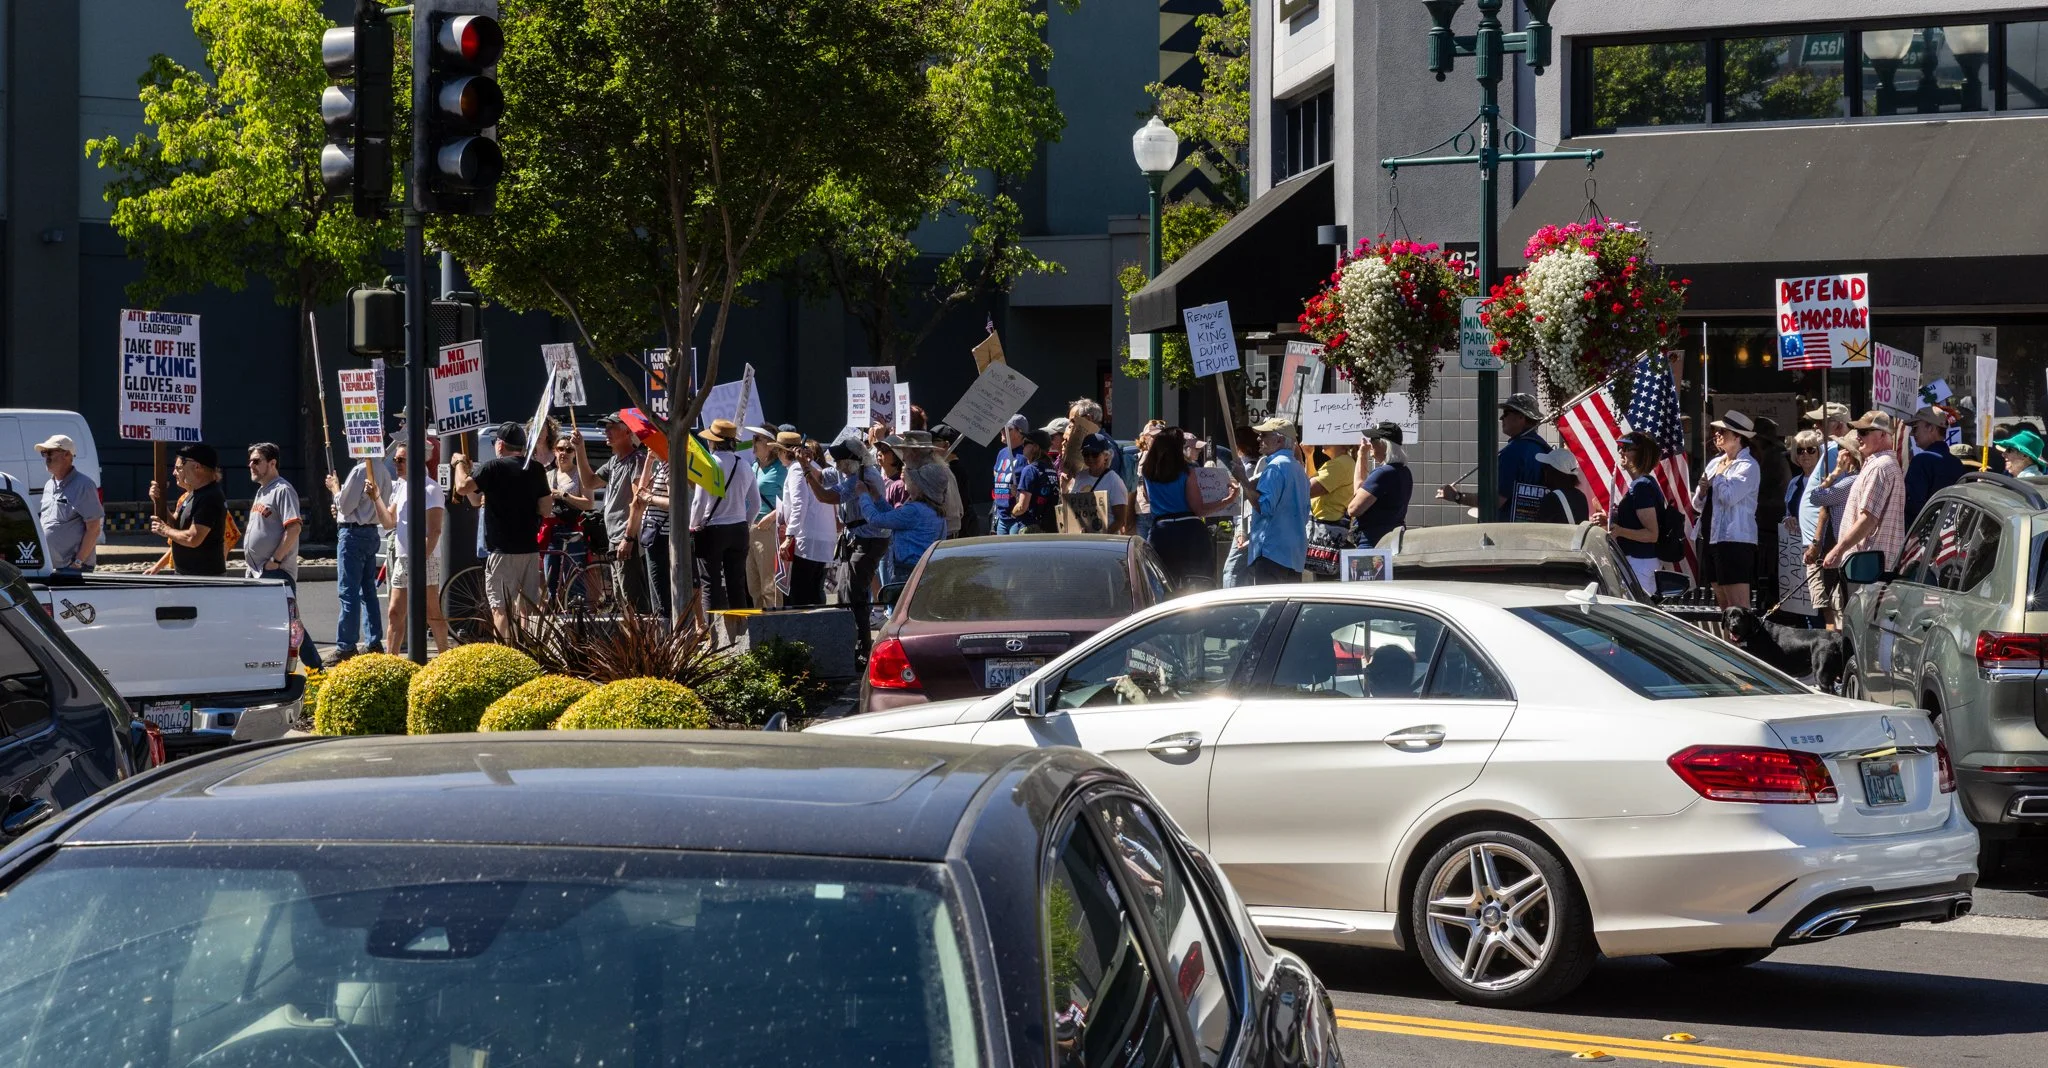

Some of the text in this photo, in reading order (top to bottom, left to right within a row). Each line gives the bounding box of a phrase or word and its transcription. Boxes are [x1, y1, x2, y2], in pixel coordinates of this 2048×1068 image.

[1781, 278, 1865, 305] DEFEND
[128, 311, 192, 326] ATTN: DEMOCRATIC
[1186, 310, 1224, 323] REMOVE
[1781, 306, 1868, 332] DEMOCRACY
[139, 323, 182, 336] LEADERSHIP
[1199, 321, 1216, 329] THE
[1197, 328, 1227, 342] KING
[125, 338, 196, 357] TAKE OFF THE
[1200, 343, 1229, 357] DUMP
[447, 349, 464, 362] NO
[1474, 358, 1492, 366] ZONE
[1876, 347, 1891, 367] NO
[434, 358, 479, 379] IMMUNITY
[1196, 356, 1236, 372] TRUMP
[868, 370, 890, 384] KINGS
[1875, 369, 1891, 387] NO
[1891, 374, 1917, 394] TYRANT
[125, 376, 196, 394] GLOVES & DO
[127, 392, 194, 403] WHAT IT TAKES TO
[1875, 388, 1891, 403] NO
[130, 401, 190, 415] PRESERVE
[449, 394, 473, 414] ICE
[1313, 399, 1353, 414] Impeach
[155, 418, 166, 426] THE
[439, 409, 486, 432] CRIMES
[122, 425, 199, 441] CONSTITUTION
[1790, 531, 1802, 580] ABOVE
[1779, 537, 1791, 600] NO ONE
[1131, 648, 1145, 661] THINGS
[1146, 653, 1156, 665] ARE
[1790, 734, 1824, 744] E 350
